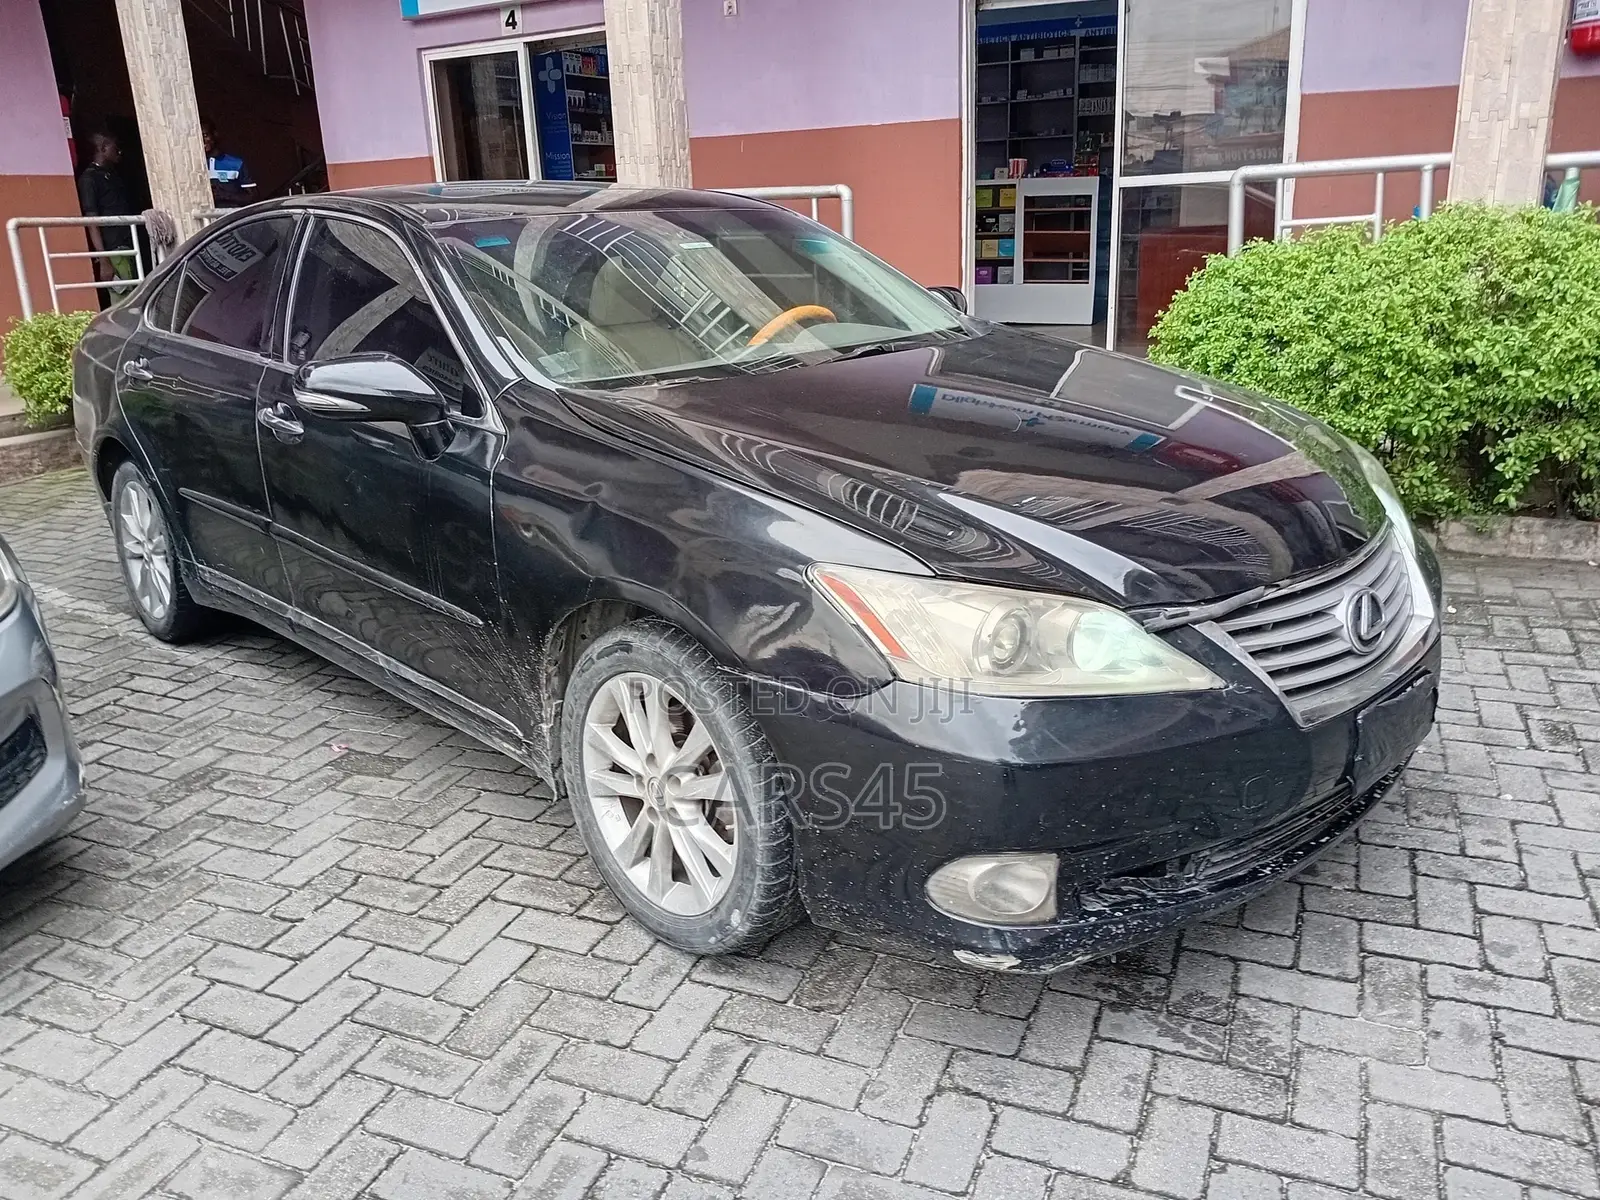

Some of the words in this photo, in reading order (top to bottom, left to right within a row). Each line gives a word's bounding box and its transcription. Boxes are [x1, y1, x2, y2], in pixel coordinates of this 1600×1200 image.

[505, 10, 517, 30] 4
[545, 111, 566, 120] Vision
[545, 151, 570, 161] Mission
